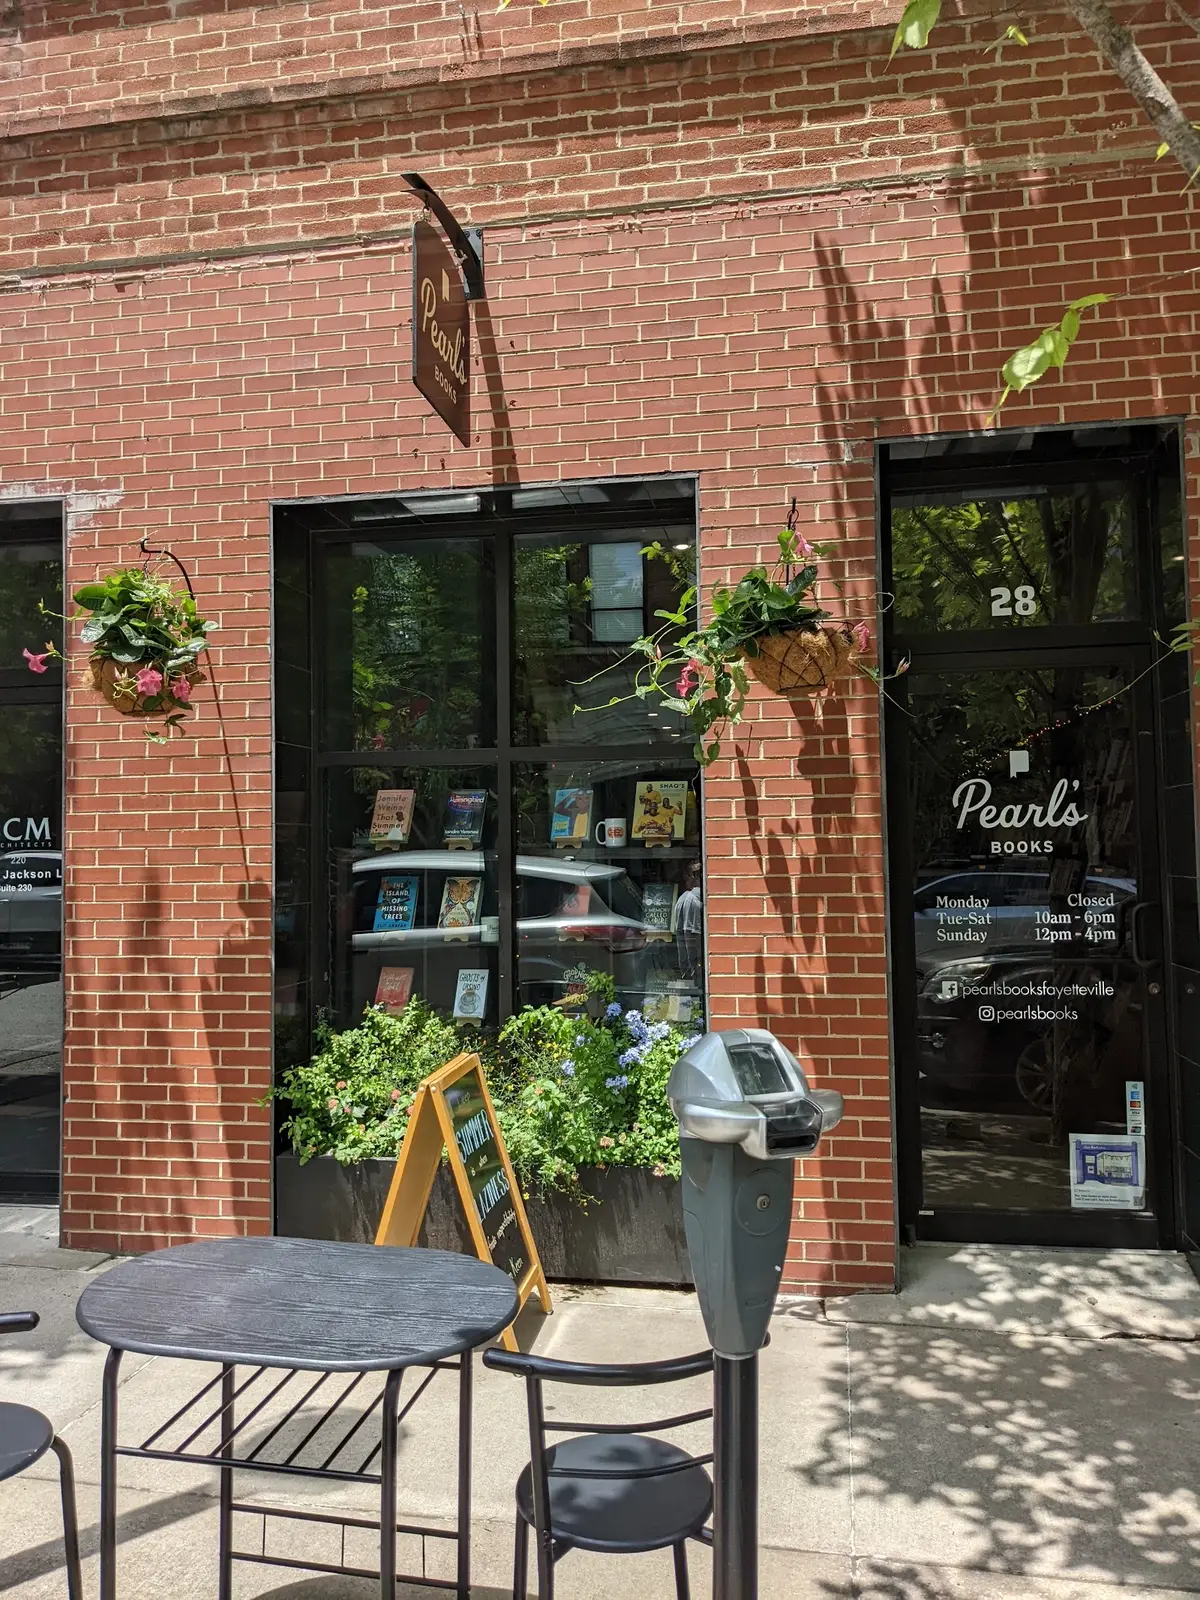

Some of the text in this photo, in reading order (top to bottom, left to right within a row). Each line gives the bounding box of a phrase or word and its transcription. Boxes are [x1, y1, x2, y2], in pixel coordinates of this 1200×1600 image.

[434, 364, 457, 404] BOOKS
[990, 585, 1037, 617] 28
[376, 813, 394, 821] That
[372, 821, 405, 829] Summer
[991, 840, 1054, 854] BOOKS
[10, 856, 27, 864] 220
[3, 869, 52, 879] Jackson
[18, 884, 33, 892] 230
[935, 893, 1116, 910] Monday Closed
[936, 912, 992, 925] Tue-Sat
[1034, 911, 1072, 924] 10am
[1084, 911, 1116, 925] 6pm
[937, 928, 988, 943] Sunday
[1034, 928, 1072, 942] 12pm
[1084, 928, 1117, 942] 4pm
[962, 981, 1115, 999] pearlsbooksfayetteville
[997, 1005, 1079, 1023] pearlsbooks
[455, 1108, 494, 1164] SUMMER
